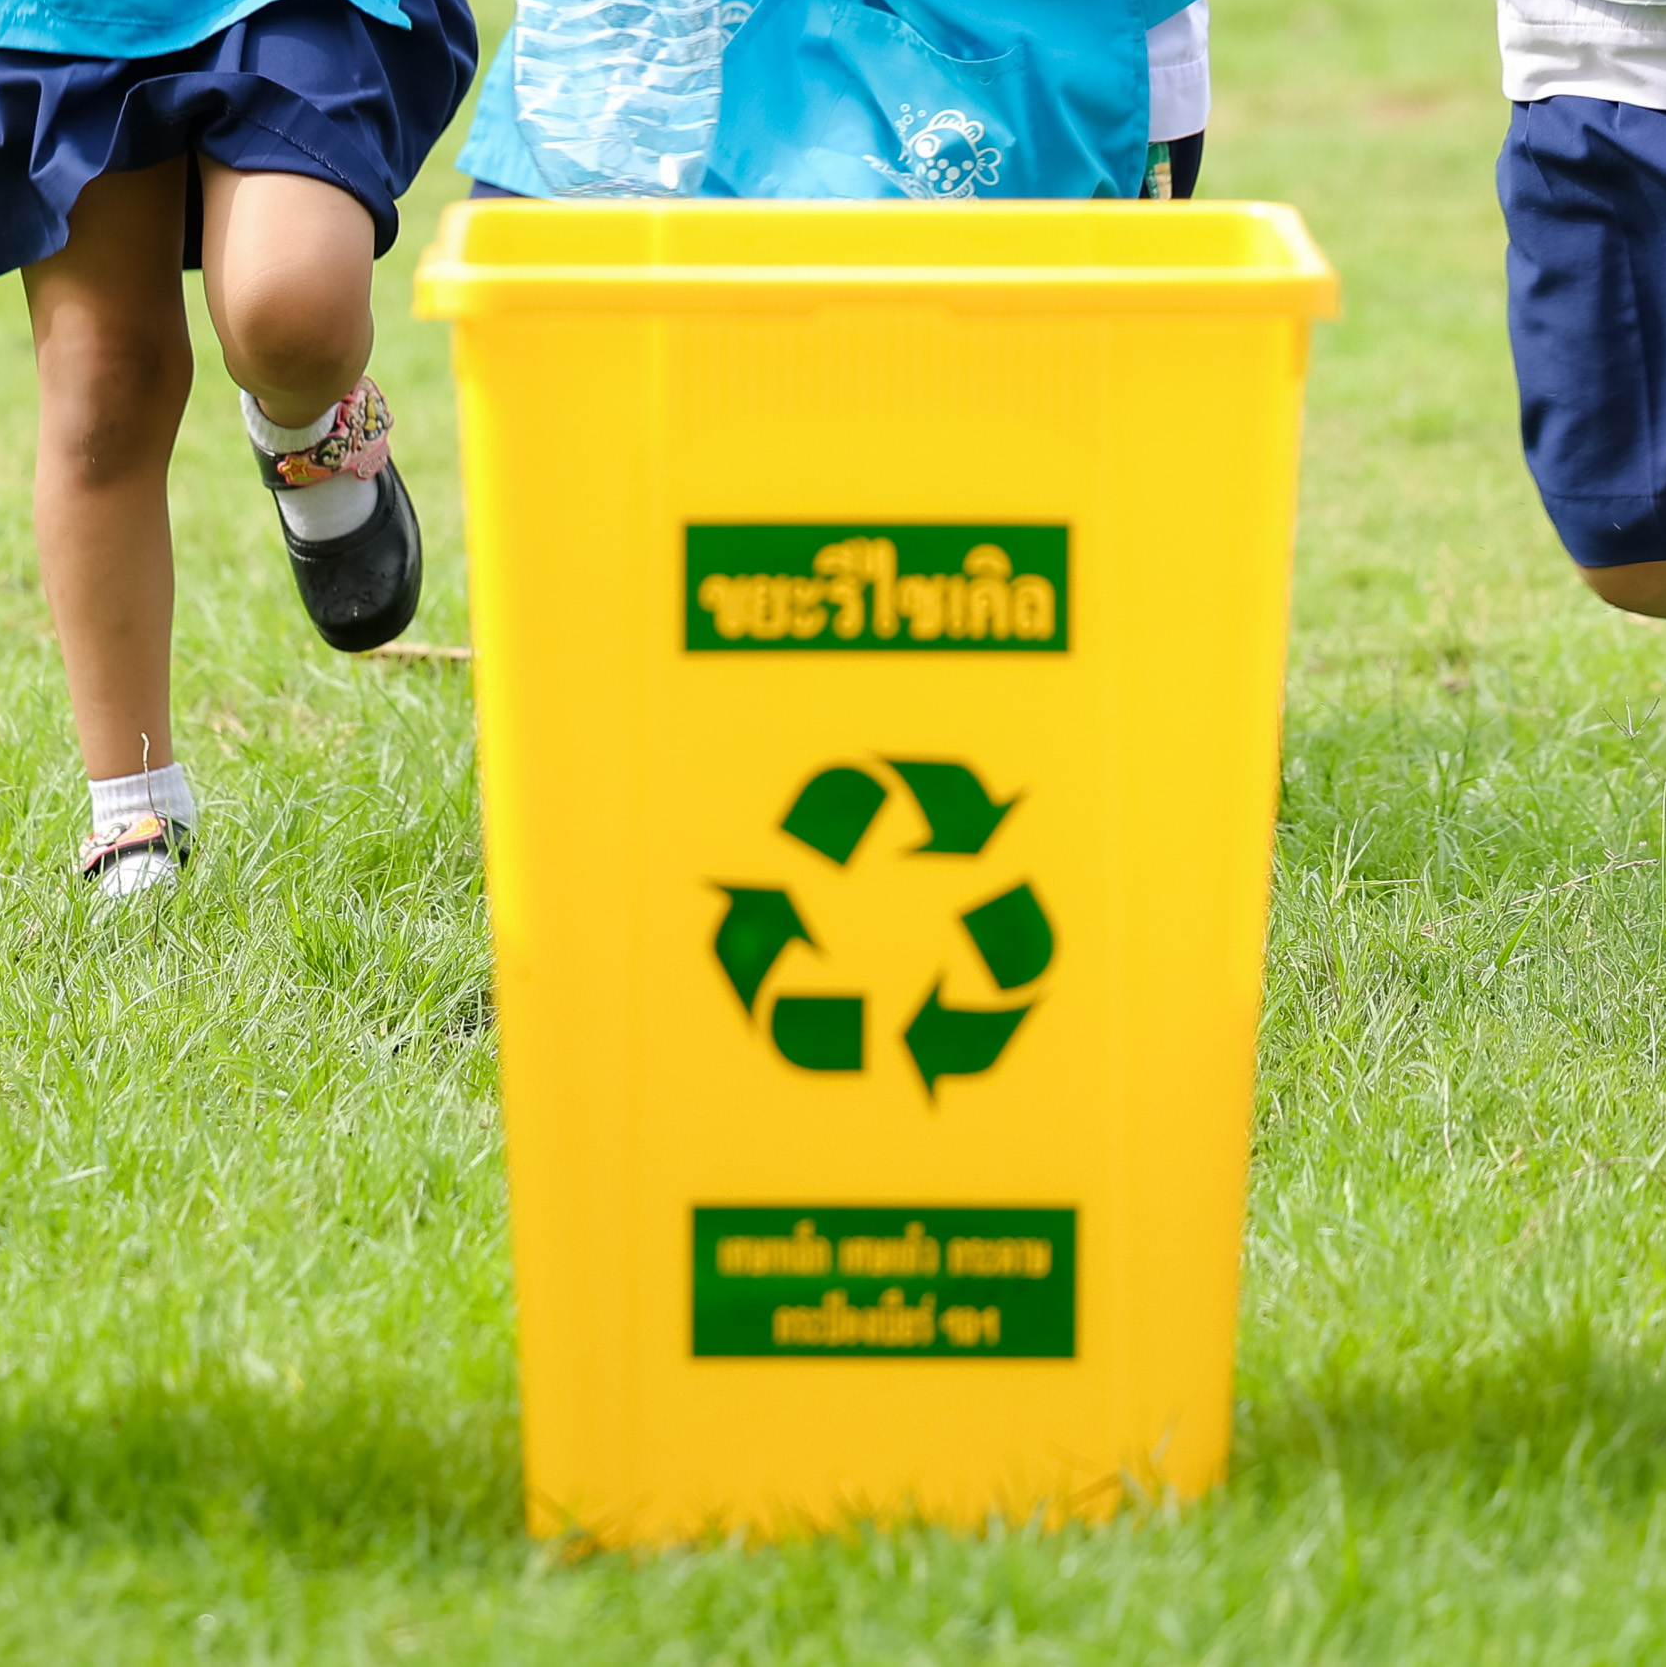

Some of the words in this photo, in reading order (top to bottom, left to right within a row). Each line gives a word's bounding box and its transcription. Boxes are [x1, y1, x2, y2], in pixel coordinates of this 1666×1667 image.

[696, 534, 1057, 641] ขยะรีไซเคิล
